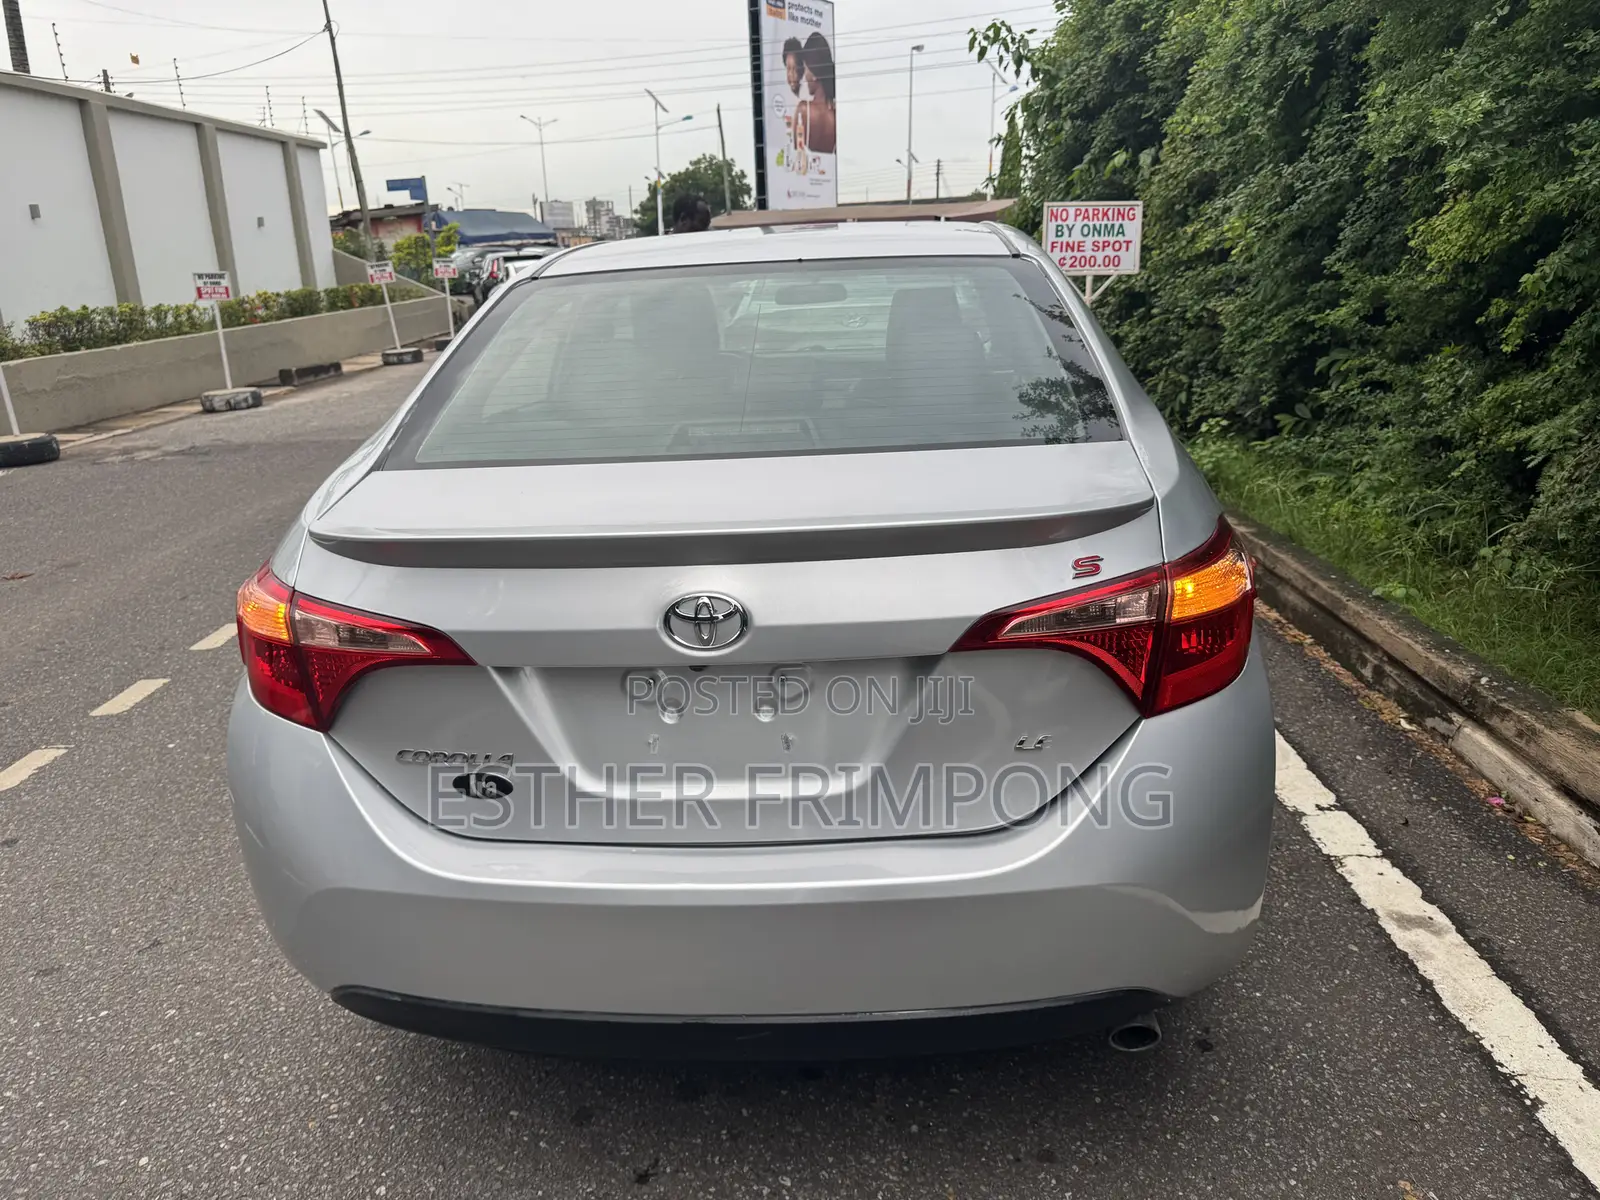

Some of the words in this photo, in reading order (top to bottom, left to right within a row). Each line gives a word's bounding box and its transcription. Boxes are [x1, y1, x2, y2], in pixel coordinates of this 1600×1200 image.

[788, 2, 813, 15] protects
[815, 9, 823, 18] me
[788, 12, 799, 22] like
[800, 17, 822, 28] mother
[1049, 208, 1069, 222] NO
[1074, 207, 1136, 221] PARKING
[1055, 224, 1075, 238] BY
[1080, 223, 1126, 238] ONMA
[1050, 241, 1086, 253] FINE
[1091, 240, 1132, 252] SPOT
[1058, 255, 1121, 268] ¢200.00
[1071, 555, 1104, 580] S
[395, 749, 514, 766] COROLLA
